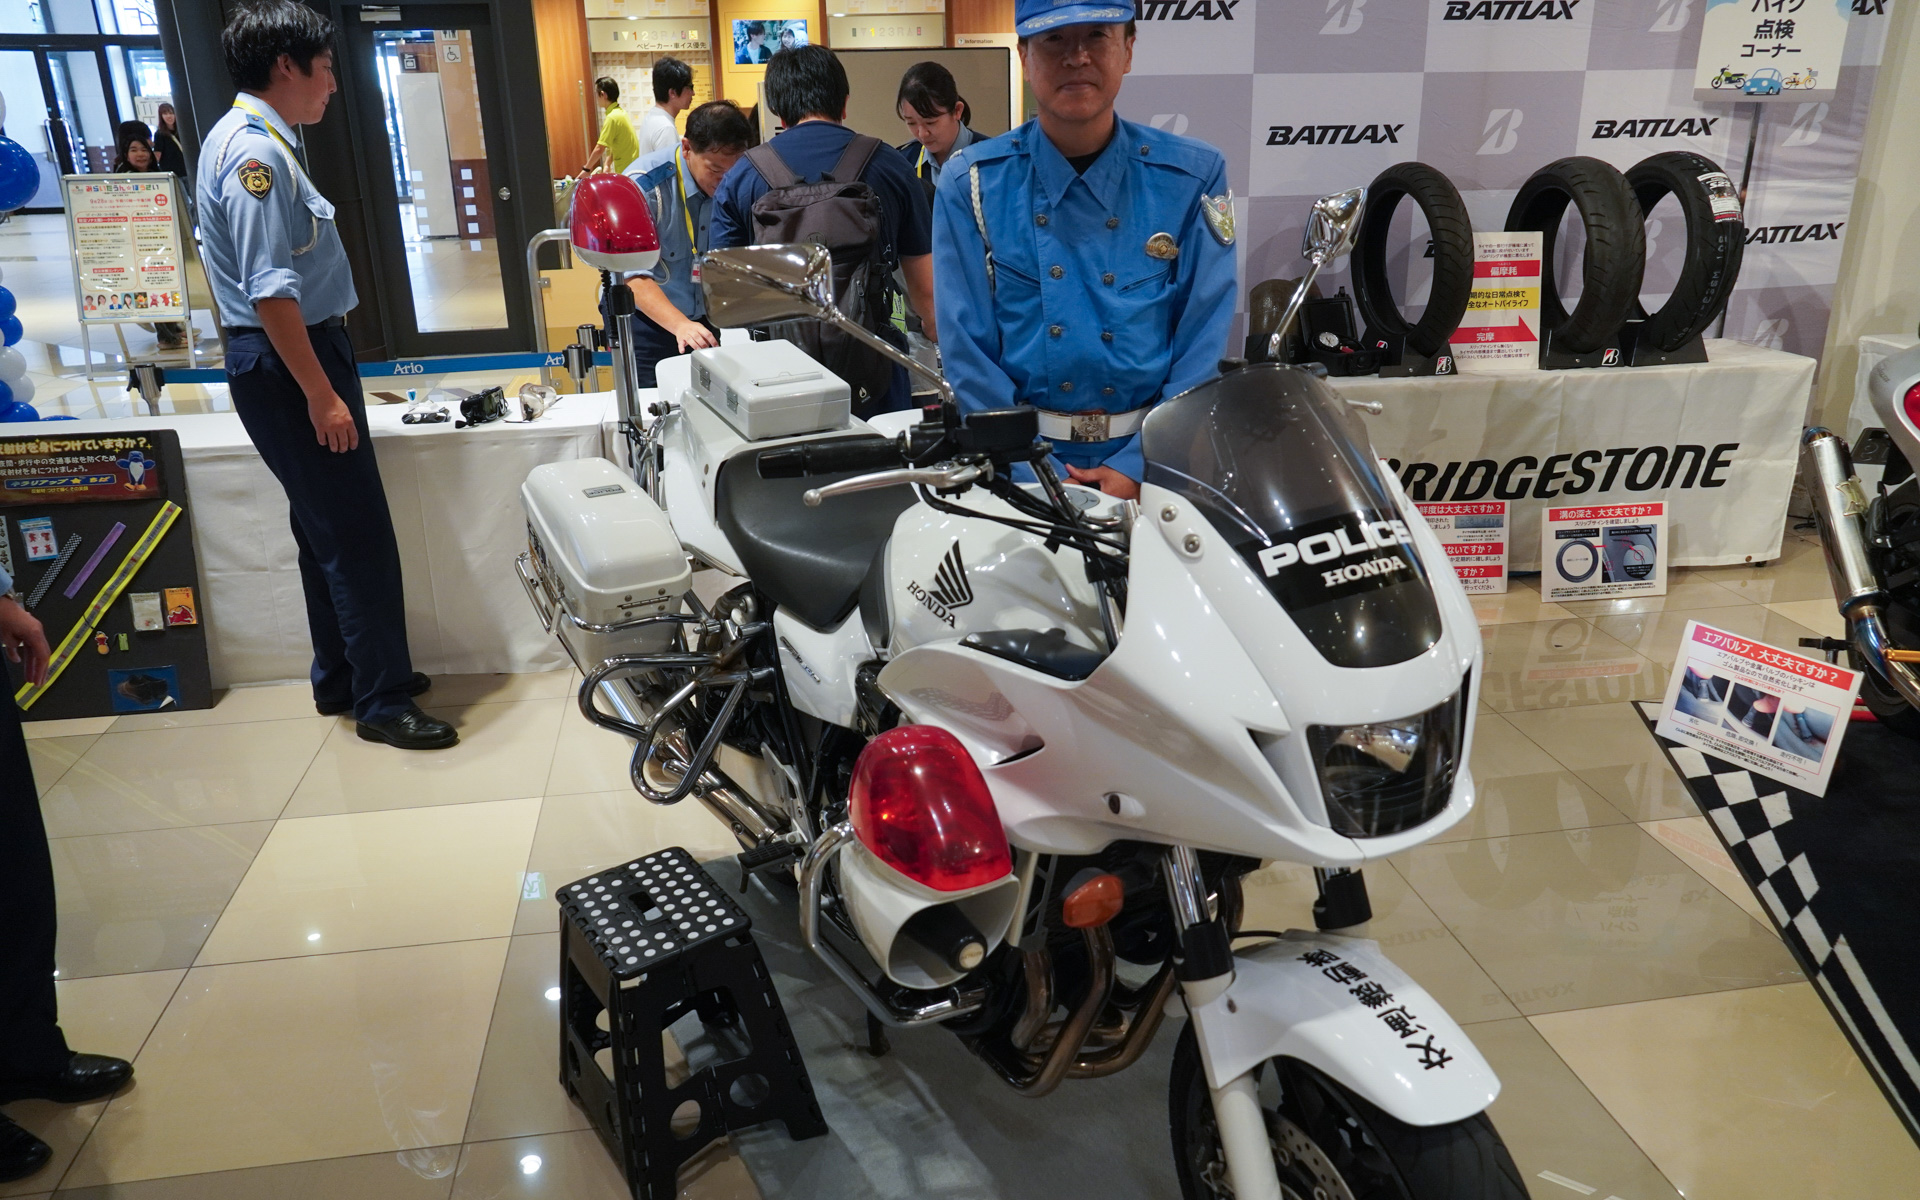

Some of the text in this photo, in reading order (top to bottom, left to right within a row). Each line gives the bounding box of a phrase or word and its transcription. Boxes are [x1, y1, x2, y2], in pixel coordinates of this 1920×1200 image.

[1443, 0, 1580, 20] BATTLAX
[1754, 19, 1795, 39] 点検
[1741, 43, 1801, 58] コーナー
[1266, 124, 1405, 146] BATTLAX
[1591, 117, 1719, 139] BATTLAX
[1490, 266, 1518, 277] 偏摩耗
[1476, 332, 1495, 342] 完摩
[393, 362, 424, 375] Ario
[1388, 442, 1740, 502] RIDGESTONE
[1559, 506, 1652, 519] 溝の深さ、大丈夫ですか？
[1575, 518, 1639, 527] スリップサインを確認しましょう
[1258, 520, 1412, 577] POLICE
[1321, 556, 1407, 588] HONDA
[906, 580, 956, 629] HONDA
[1702, 631, 1839, 684] エアバルブ、大丈夫ですか？
